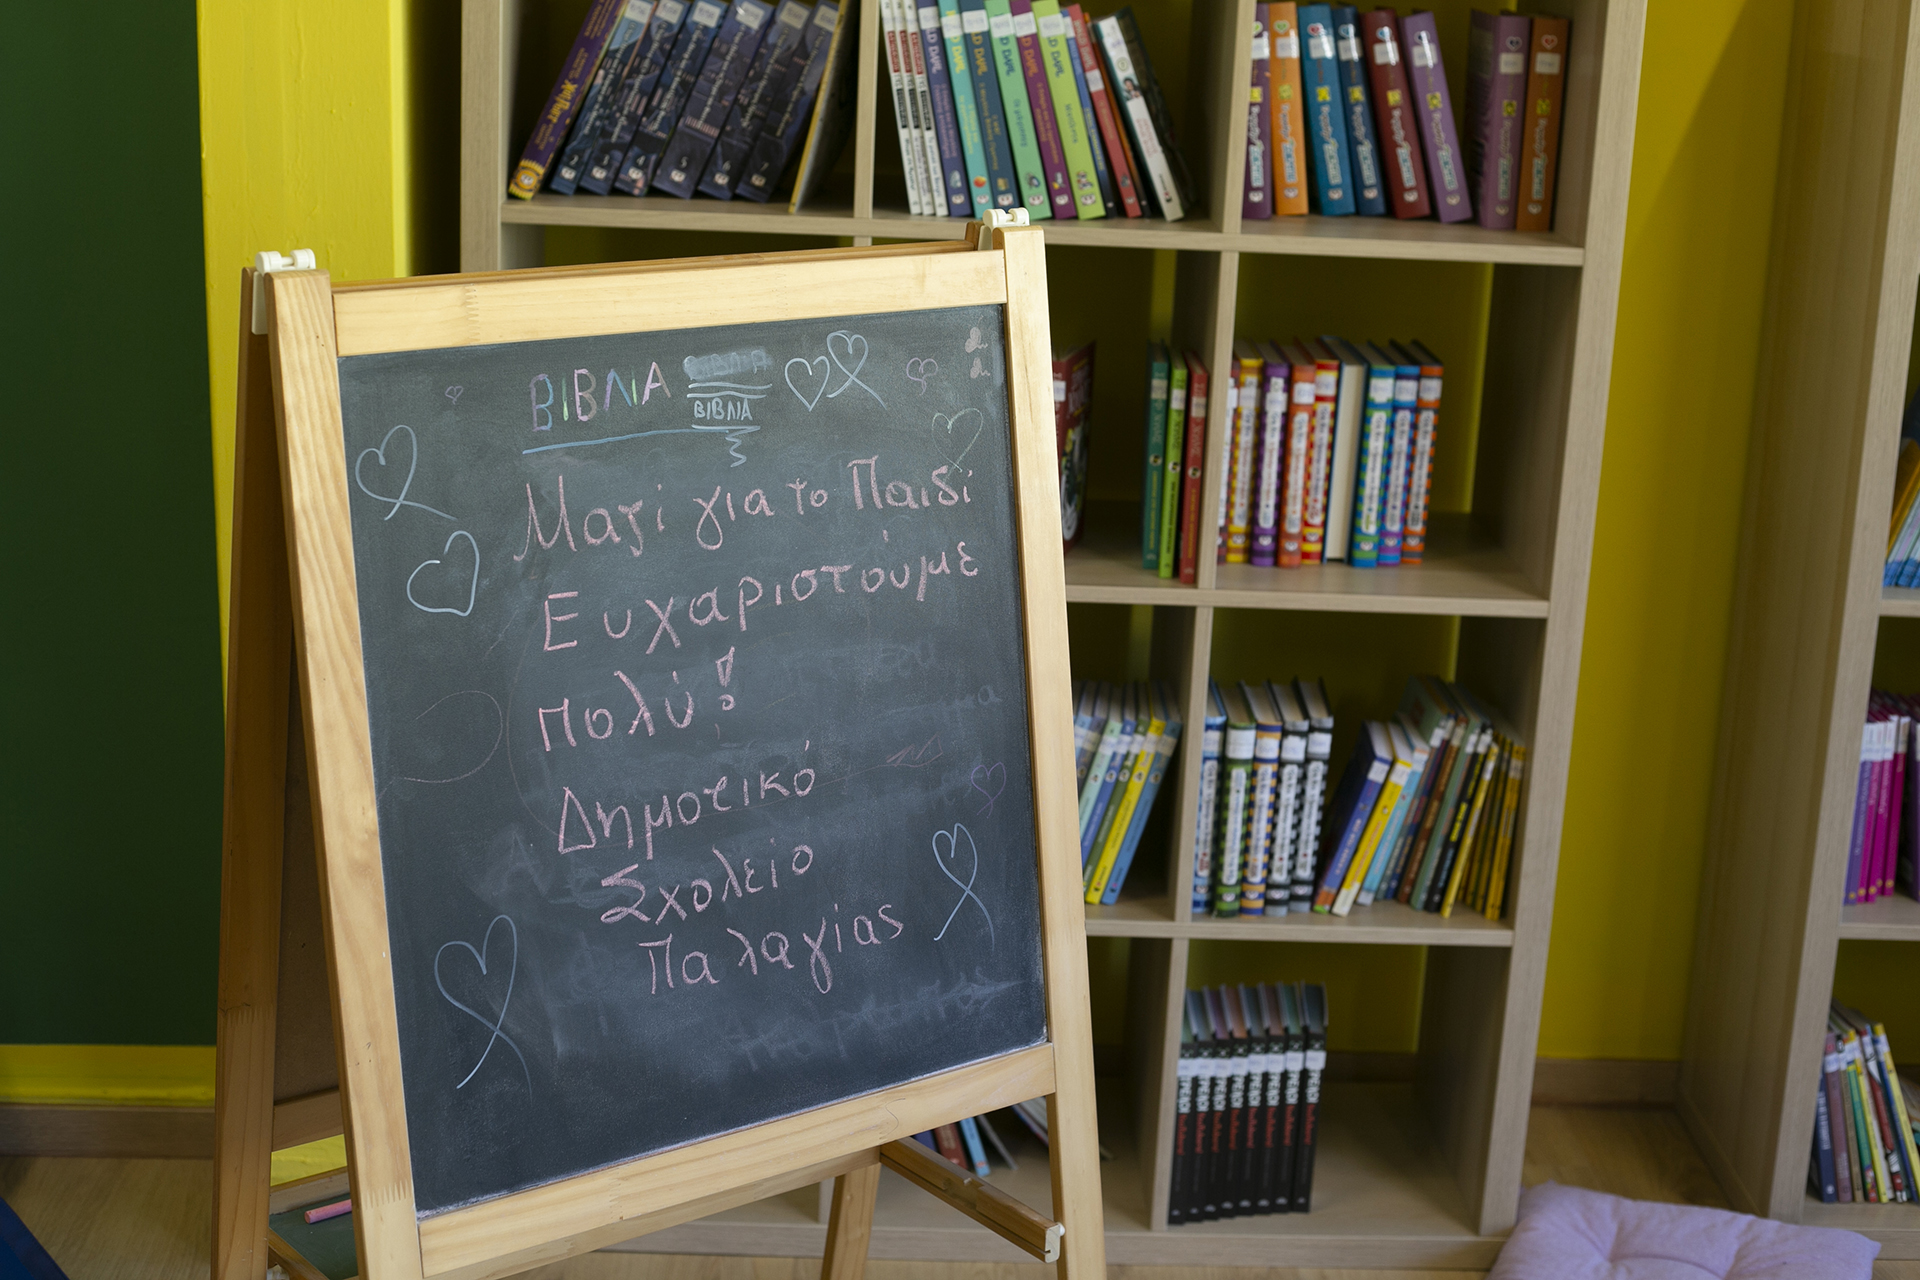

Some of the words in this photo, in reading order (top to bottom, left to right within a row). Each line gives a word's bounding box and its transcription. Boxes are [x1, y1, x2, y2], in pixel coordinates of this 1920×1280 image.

[529, 360, 671, 431] ΒΙΒΛΙΑ
[693, 397, 753, 421] ΒΙΒΛΙΑ
[693, 485, 774, 550] για
[787, 477, 828, 515] το
[847, 454, 974, 510] Παιδί
[543, 530, 979, 652] Ευχαριστούμε
[558, 740, 815, 860] Δημοτικό
[600, 838, 814, 926] Σχολείο
